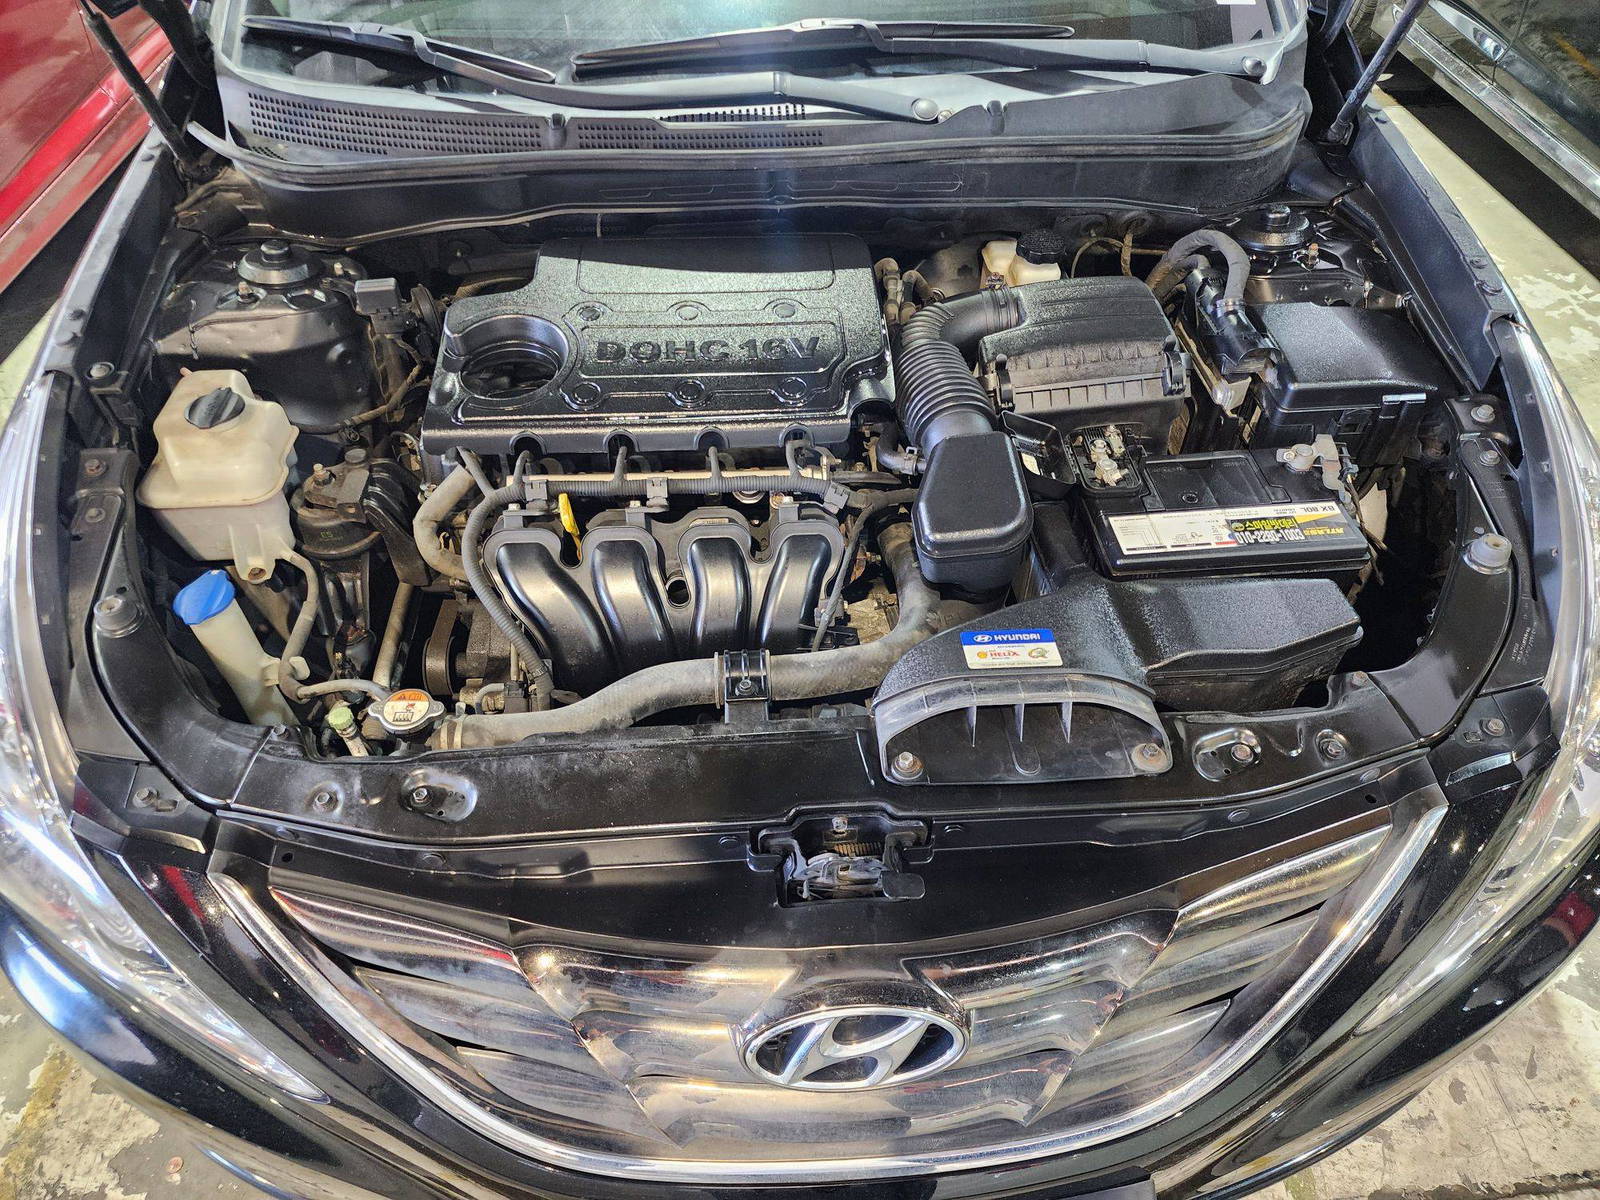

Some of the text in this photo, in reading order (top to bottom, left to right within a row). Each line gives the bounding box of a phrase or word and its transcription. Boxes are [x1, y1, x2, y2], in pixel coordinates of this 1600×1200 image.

[596, 335, 821, 363] DOHC 16V
[1235, 528, 1306, 544] 010-2280-1003
[994, 633, 1041, 642] HYUNDAI
